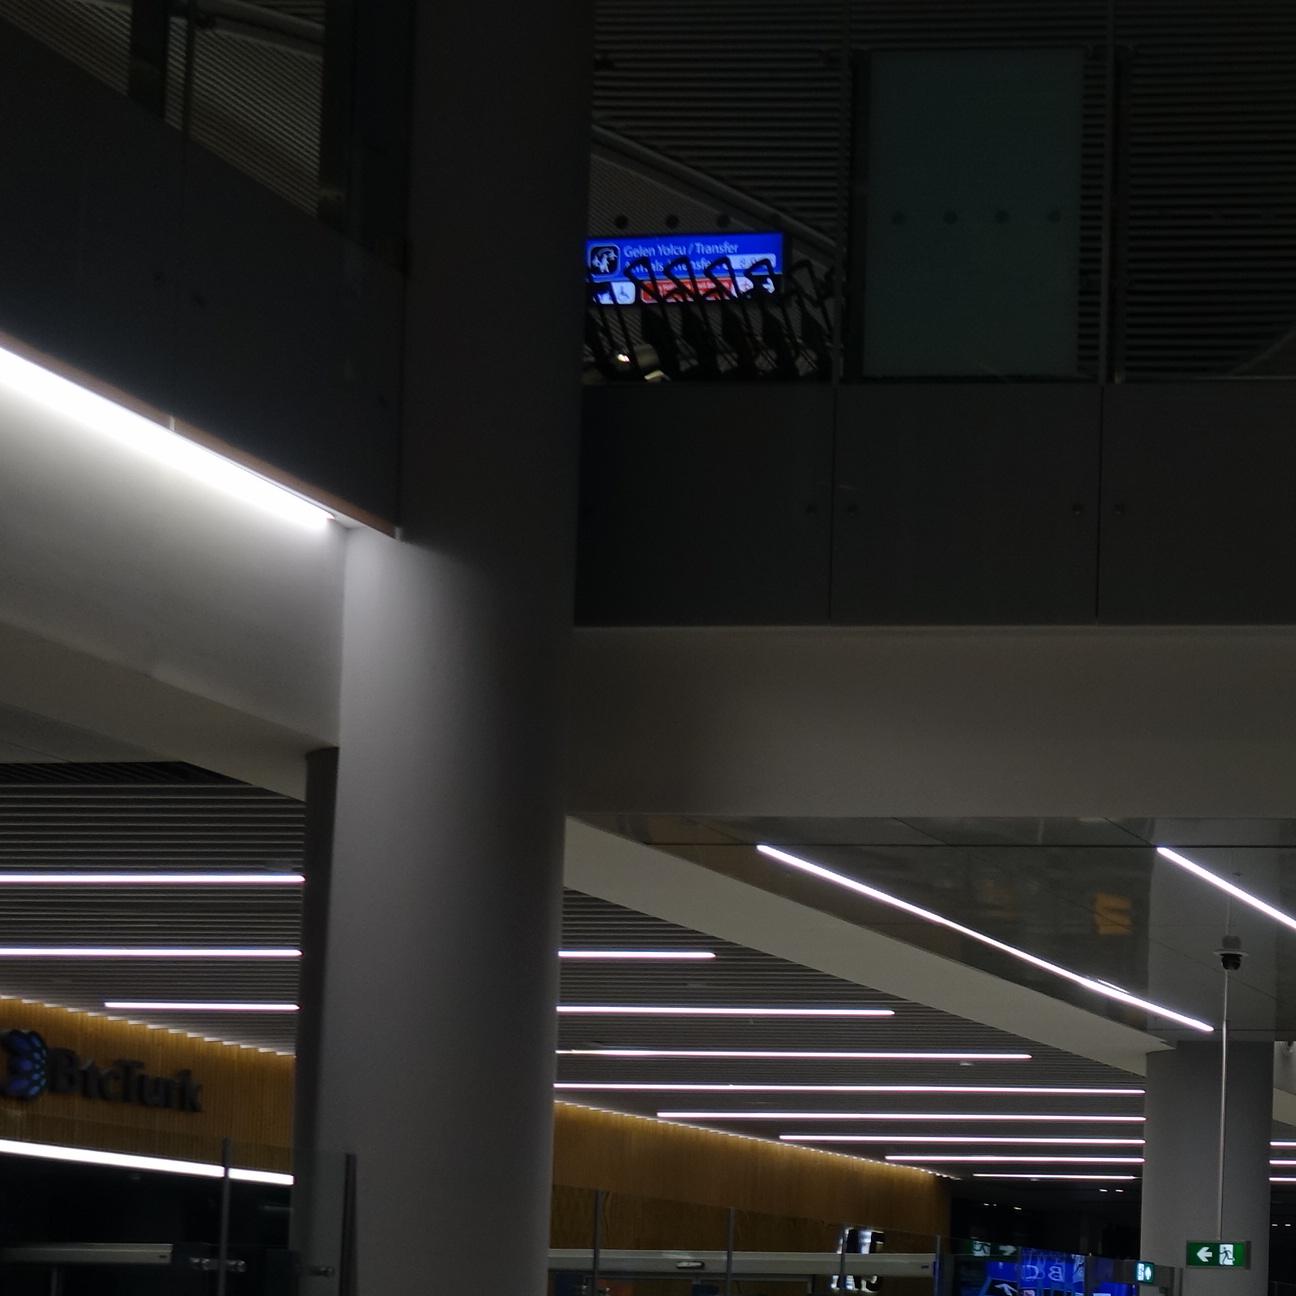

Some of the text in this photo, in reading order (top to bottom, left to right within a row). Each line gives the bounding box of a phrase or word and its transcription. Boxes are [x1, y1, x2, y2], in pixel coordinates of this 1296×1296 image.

[624, 245, 656, 257] Gelen
[658, 243, 686, 255] Yolcu
[696, 240, 739, 254] Transfer
[48, 1048, 204, 1112] BtcTurk
